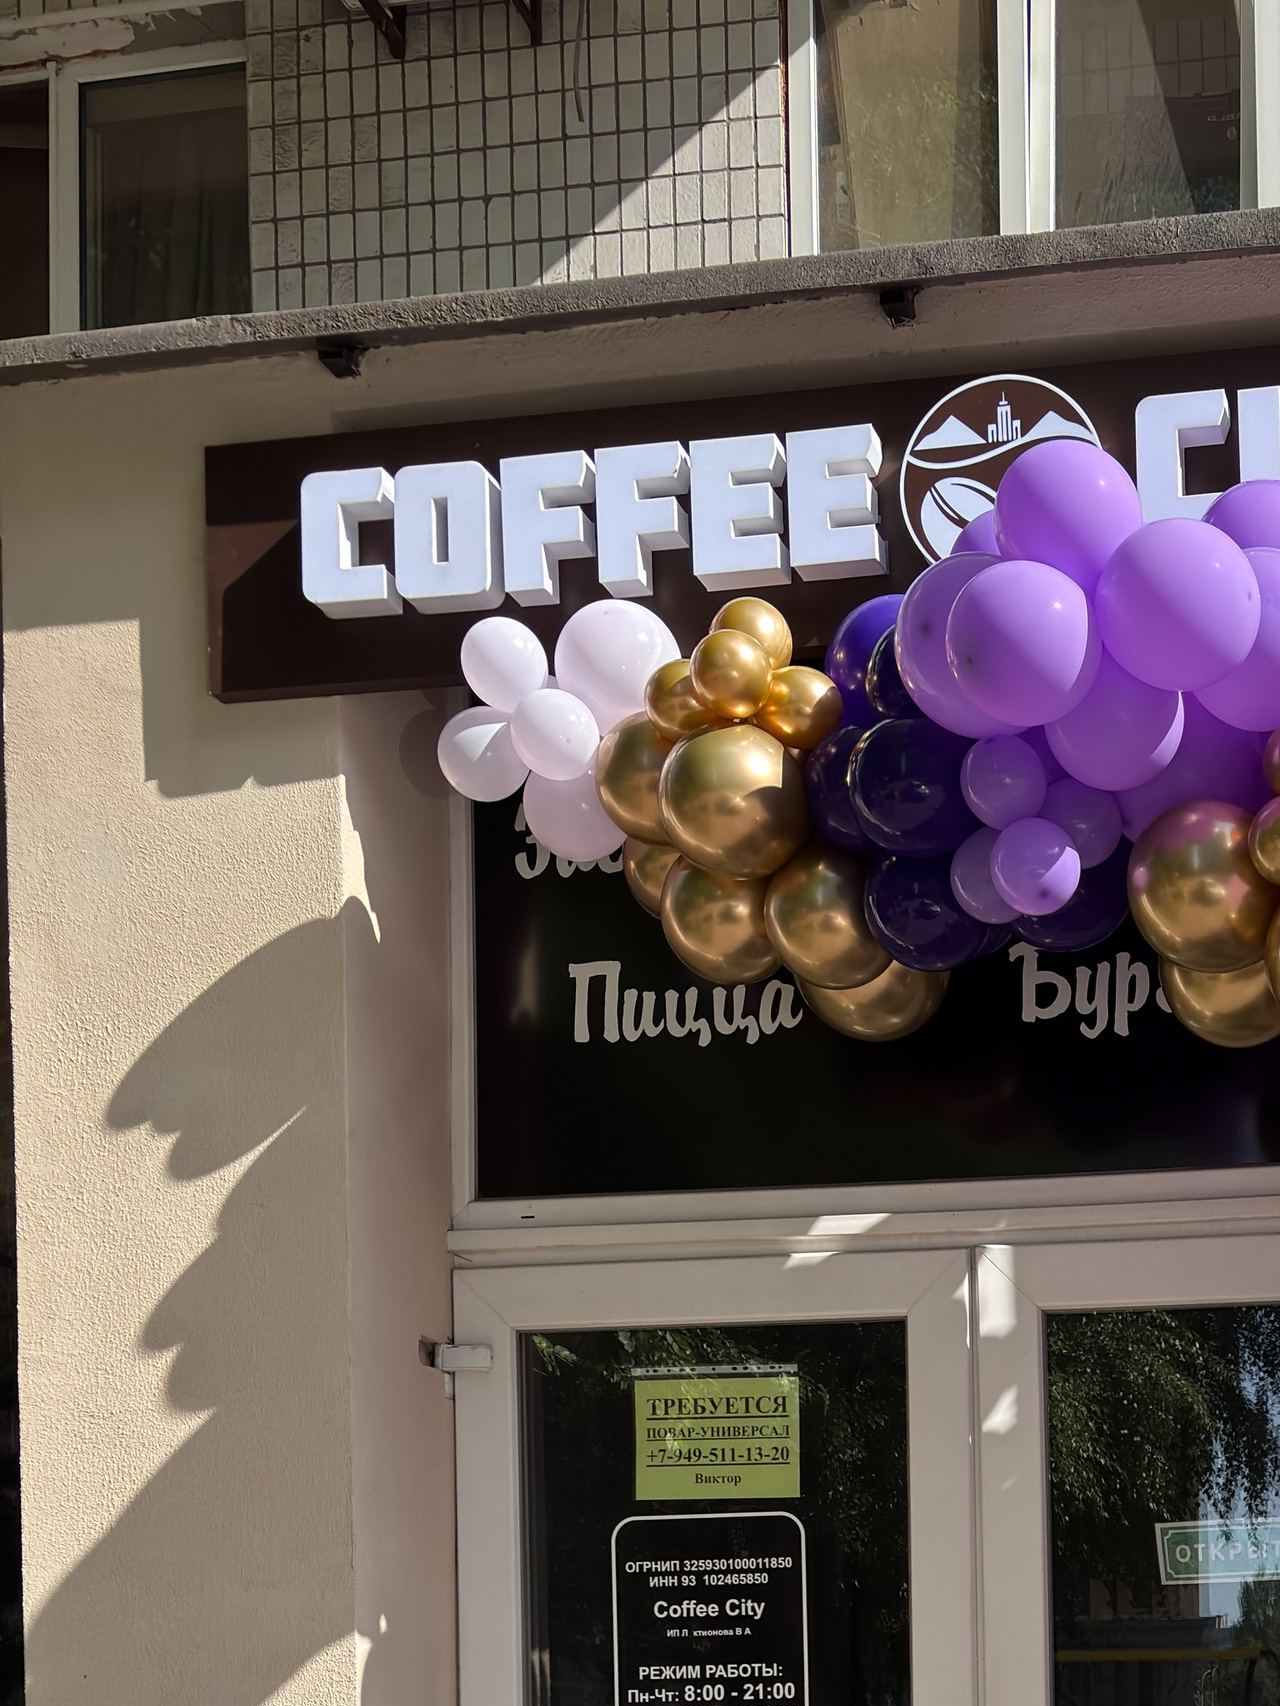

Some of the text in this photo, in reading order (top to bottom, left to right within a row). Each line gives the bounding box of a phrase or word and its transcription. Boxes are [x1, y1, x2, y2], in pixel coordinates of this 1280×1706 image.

[301, 423, 887, 619] COFFEE
[1009, 941, 1173, 1039] Бур
[568, 960, 803, 1047] Пицца
[646, 1395, 788, 1417] ТРЕБУЕТСЯ
[646, 1424, 790, 1439] ПОВАР-УНИВЕРСАЛ
[646, 1446, 790, 1464] +7-949-511-13-20
[694, 1472, 742, 1486] Виктор
[625, 1556, 793, 1573] ОГРНИП 325930100011850
[649, 1576, 678, 1587] ИНН
[653, 1599, 766, 1620] Coffee City
[666, 1629, 680, 1637] ИП
[638, 1663, 783, 1680] РЕЖИМ РАБОТЫ:
[627, 1689, 680, 1703] Пн-Чт:
[684, 1684, 725, 1702] 8:00
[743, 1682, 796, 1700] 21:00
